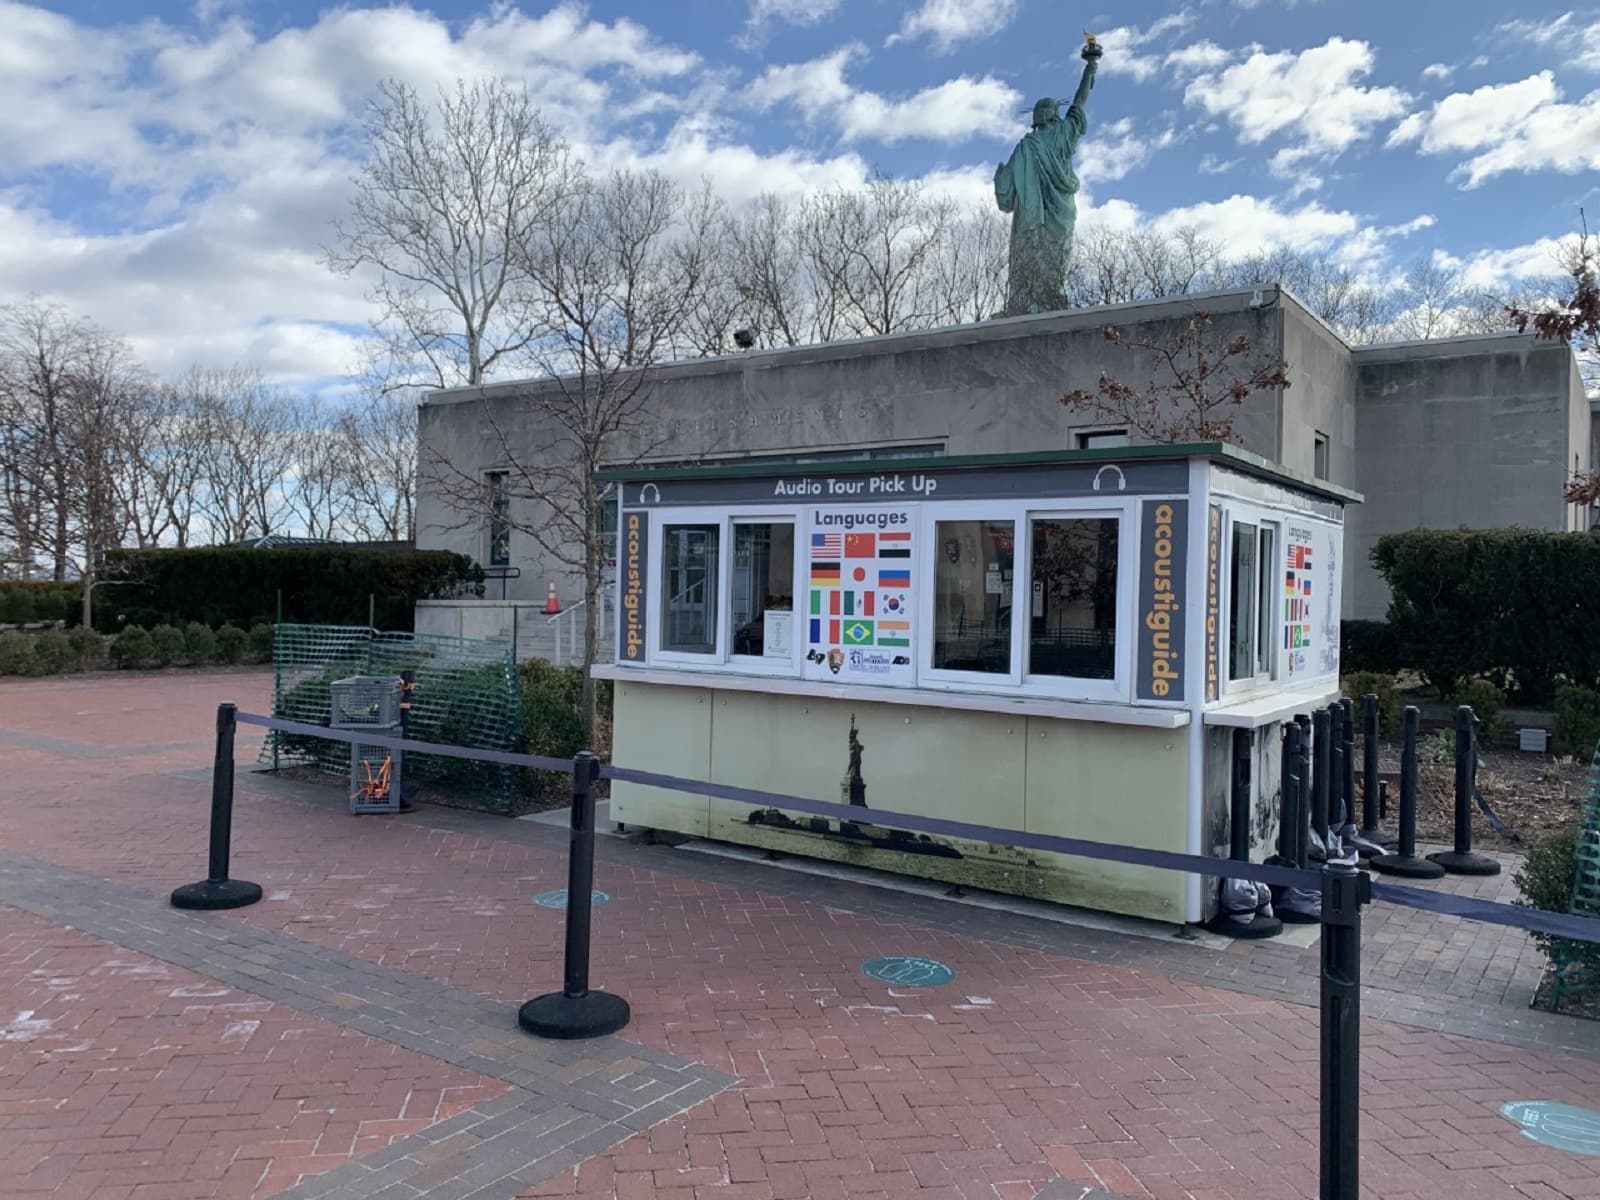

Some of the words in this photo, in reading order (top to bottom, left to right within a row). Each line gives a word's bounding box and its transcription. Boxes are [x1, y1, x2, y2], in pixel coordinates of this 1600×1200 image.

[774, 479, 822, 496] Audio
[827, 478, 865, 494] Tour
[869, 475, 905, 493] Pick
[911, 475, 937, 496] Up
[815, 510, 908, 529] Languages
[1288, 521, 1312, 543] Languages
[624, 514, 642, 659] acoustiguide
[1145, 504, 1179, 697] acoustiguide
[1207, 510, 1219, 699] acoustiguide
